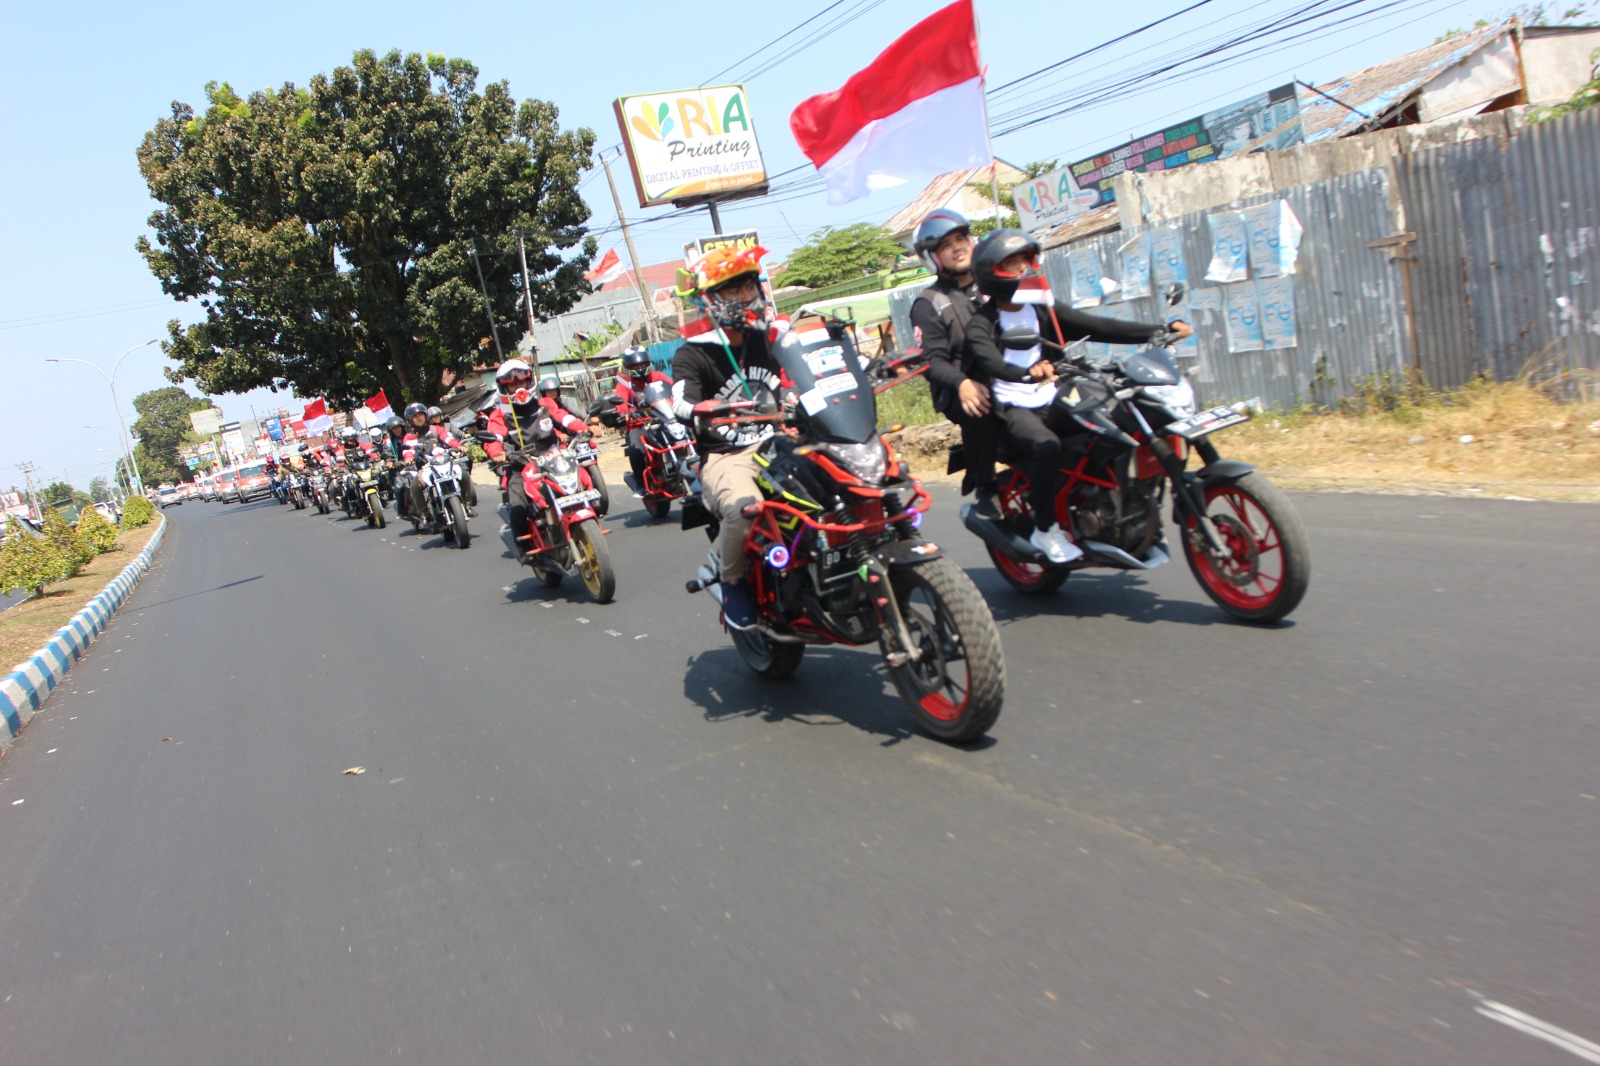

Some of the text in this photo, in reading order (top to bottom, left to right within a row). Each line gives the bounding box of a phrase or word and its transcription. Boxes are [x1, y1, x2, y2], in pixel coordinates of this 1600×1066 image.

[676, 92, 748, 138] RIA
[667, 139, 752, 161] Printing
[645, 160, 759, 184] DIGITAL PRINTING & OFFSET
[1035, 171, 1072, 209] RIA
[1034, 204, 1069, 221] Printing
[749, 366, 781, 391] HITAM
